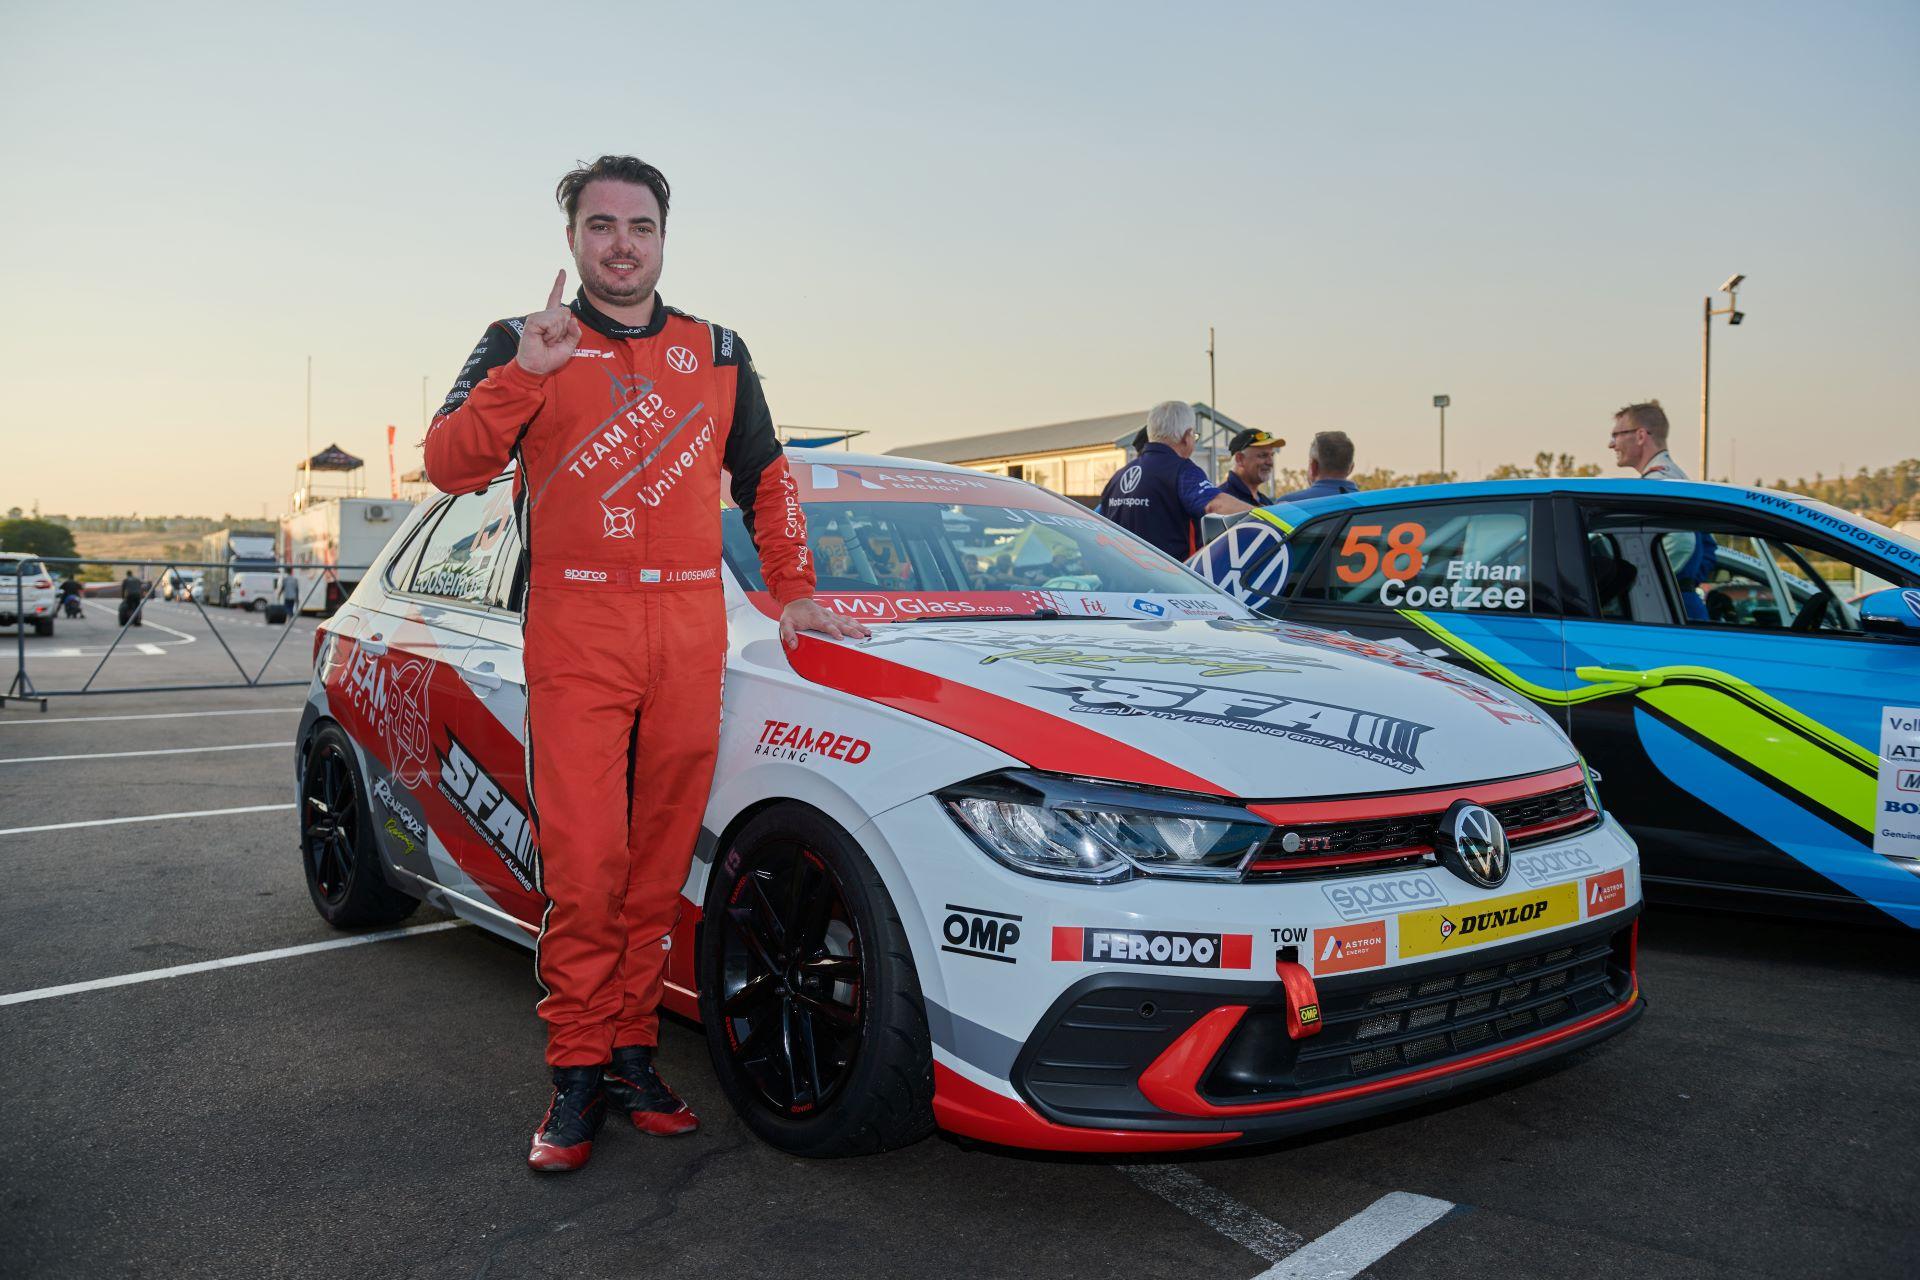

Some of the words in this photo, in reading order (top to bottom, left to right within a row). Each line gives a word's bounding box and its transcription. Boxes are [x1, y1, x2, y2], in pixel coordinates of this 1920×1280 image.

[569, 424, 628, 479] TEAM
[626, 393, 663, 429] RED
[608, 406, 676, 470] RACING
[636, 416, 717, 507] Universal
[879, 472, 988, 489] ASTRON
[1745, 491, 1920, 565] www.vwmotorspor
[1336, 522, 1426, 584] 58
[564, 569, 607, 582] sparco
[1446, 560, 1521, 581] Ethan
[1379, 578, 1526, 609] Coetzee
[338, 671, 385, 737] RACING
[1072, 705, 1186, 722] SECURITY
[1189, 714, 1286, 738] FENCING
[1329, 741, 1416, 774] ALARMS
[1890, 717, 1920, 731] Vol
[754, 744, 808, 763] RACING
[1884, 801, 1920, 814] BO
[437, 782, 467, 816] SECURITY
[465, 814, 494, 847] FENCING
[504, 857, 533, 893] ALARMS
[1515, 848, 1594, 881] sparco
[1331, 876, 1435, 914] sparco
[943, 913, 1021, 954] OMP
[1458, 900, 1548, 936] DUNLOP
[1092, 932, 1213, 963] FERODO
[1270, 927, 1308, 943] TOW
[1345, 936, 1382, 949] ASTRON
[1346, 948, 1370, 956] ENERGY
[1301, 1007, 1318, 1021] OMP
